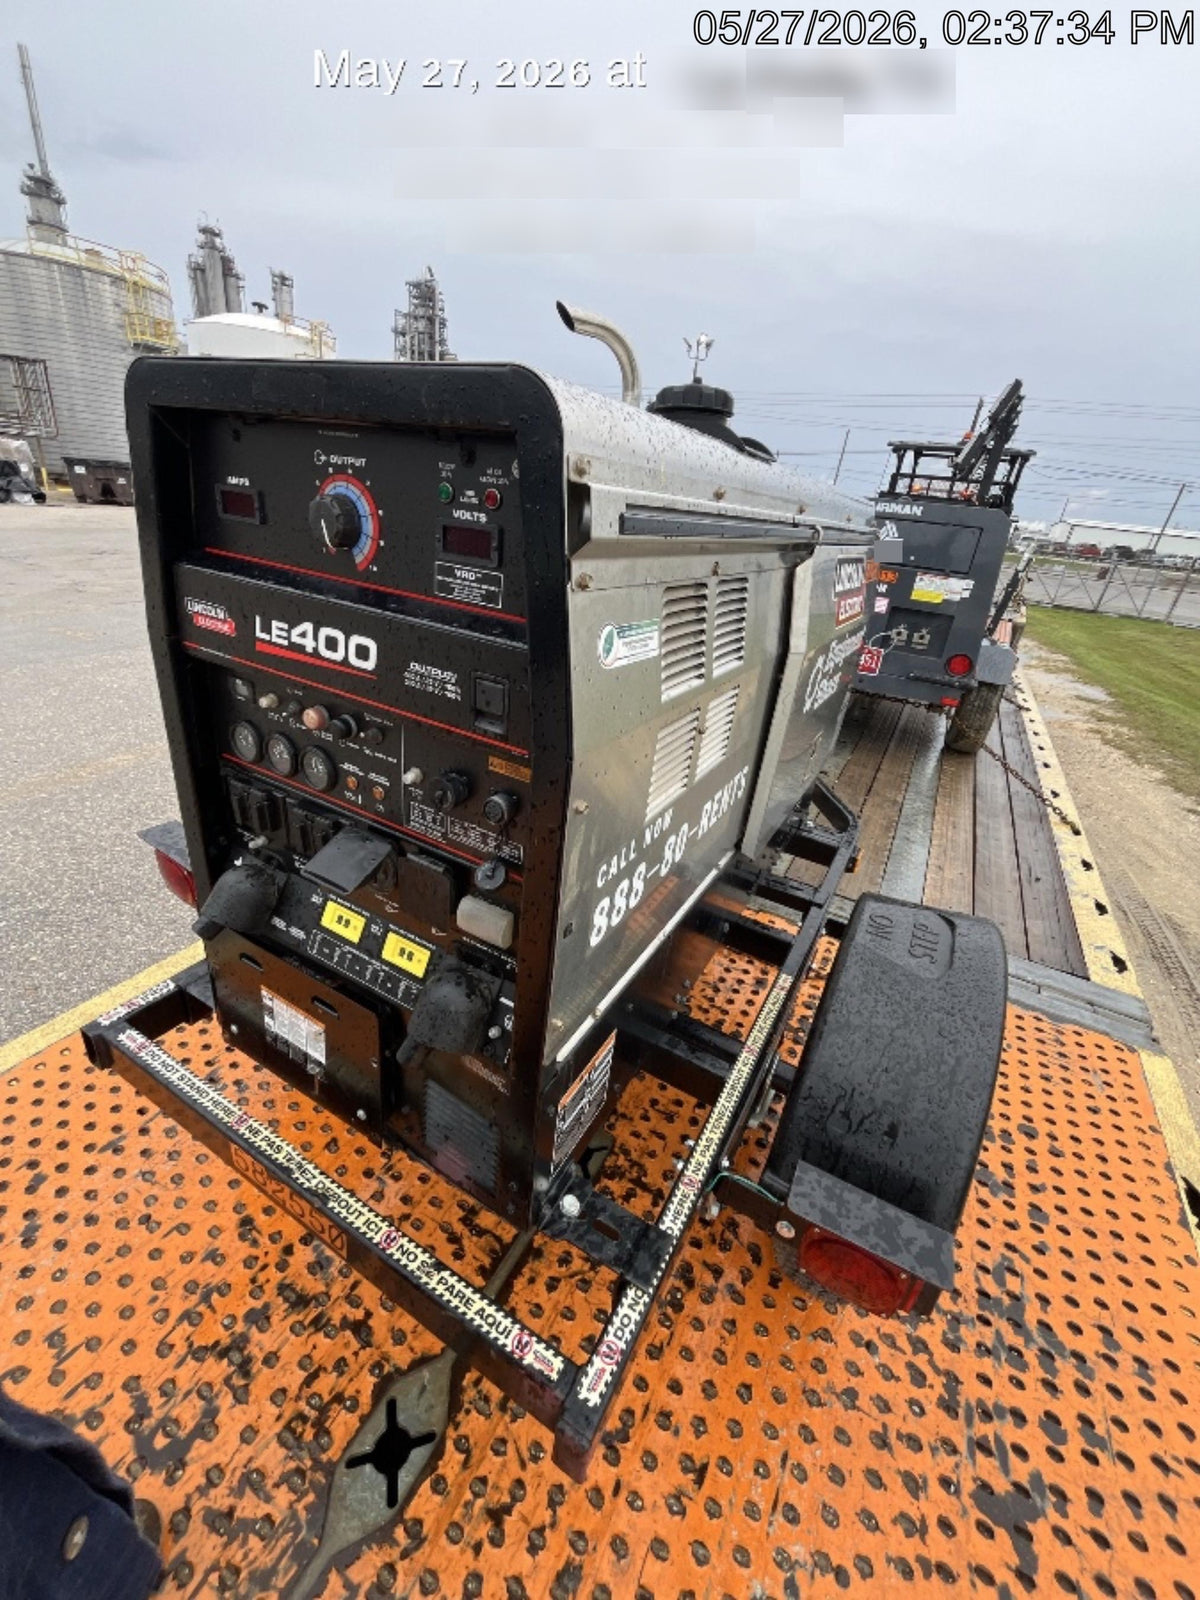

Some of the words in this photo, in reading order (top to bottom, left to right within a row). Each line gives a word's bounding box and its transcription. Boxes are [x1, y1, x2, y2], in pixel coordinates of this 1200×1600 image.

[329, 454, 367, 467] OUTPUT
[452, 508, 488, 524] VOLTS
[255, 614, 378, 671] LE400
[589, 765, 749, 948] 888-80-RENTS
[596, 838, 638, 889] CALL
[643, 807, 673, 849] NOW
[865, 914, 894, 941] NO
[908, 922, 939, 964] STEP
[161, 1060, 180, 1076] NOT
[177, 1074, 210, 1100] STAND
[207, 1096, 238, 1120] HERE
[244, 1123, 263, 1139] NE
[260, 1135, 284, 1155] PAS
[362, 1217, 383, 1236] ICI
[396, 1244, 419, 1263] NO
[436, 1276, 476, 1311] PARE
[673, 1189, 691, 1226] HERE
[700, 1137, 714, 1157] PAS
[613, 1312, 632, 1341] DO
[627, 1287, 645, 1313] NO
